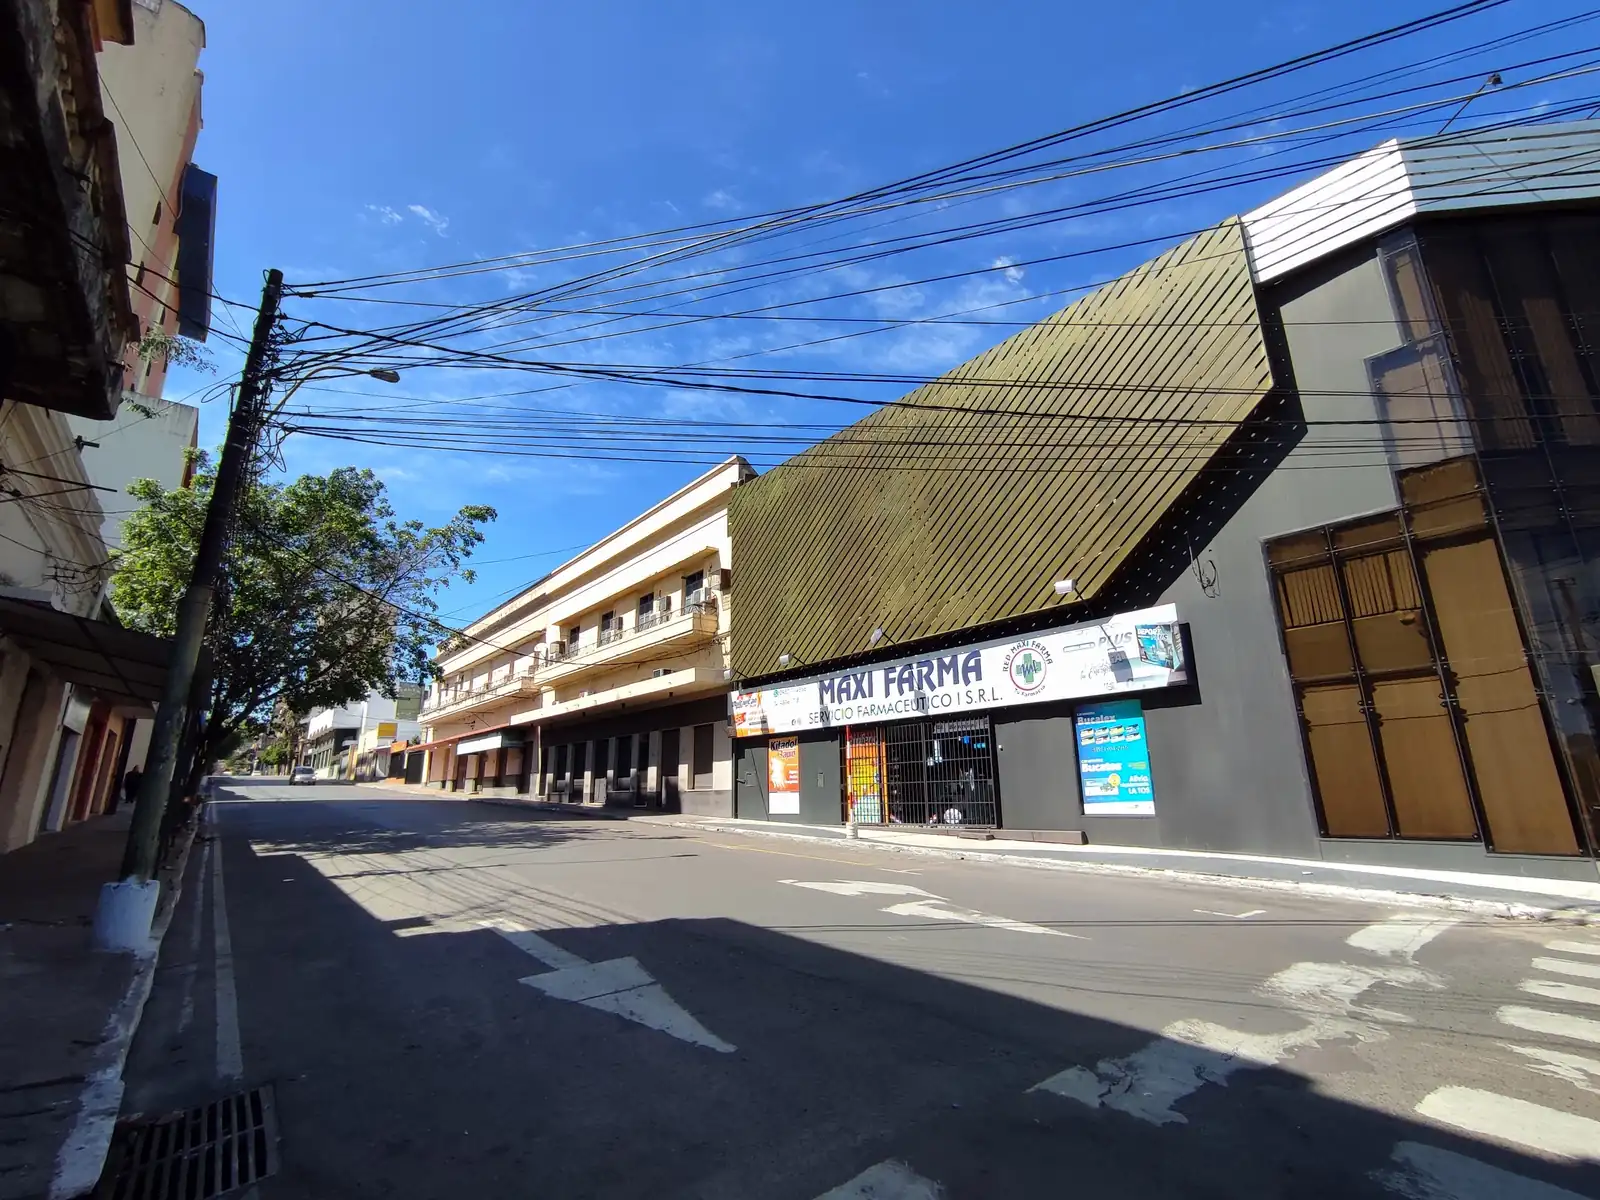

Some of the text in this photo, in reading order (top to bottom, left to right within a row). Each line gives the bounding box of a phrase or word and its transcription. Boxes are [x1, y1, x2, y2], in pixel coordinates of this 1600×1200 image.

[1002, 640, 1053, 672] RED MAXI FARMA
[818, 650, 983, 705] MAXI FARMA
[808, 707, 854, 725] SERVICIO
[857, 693, 952, 719] FARMACEUTICO
[966, 687, 1003, 705] S.R.L.
